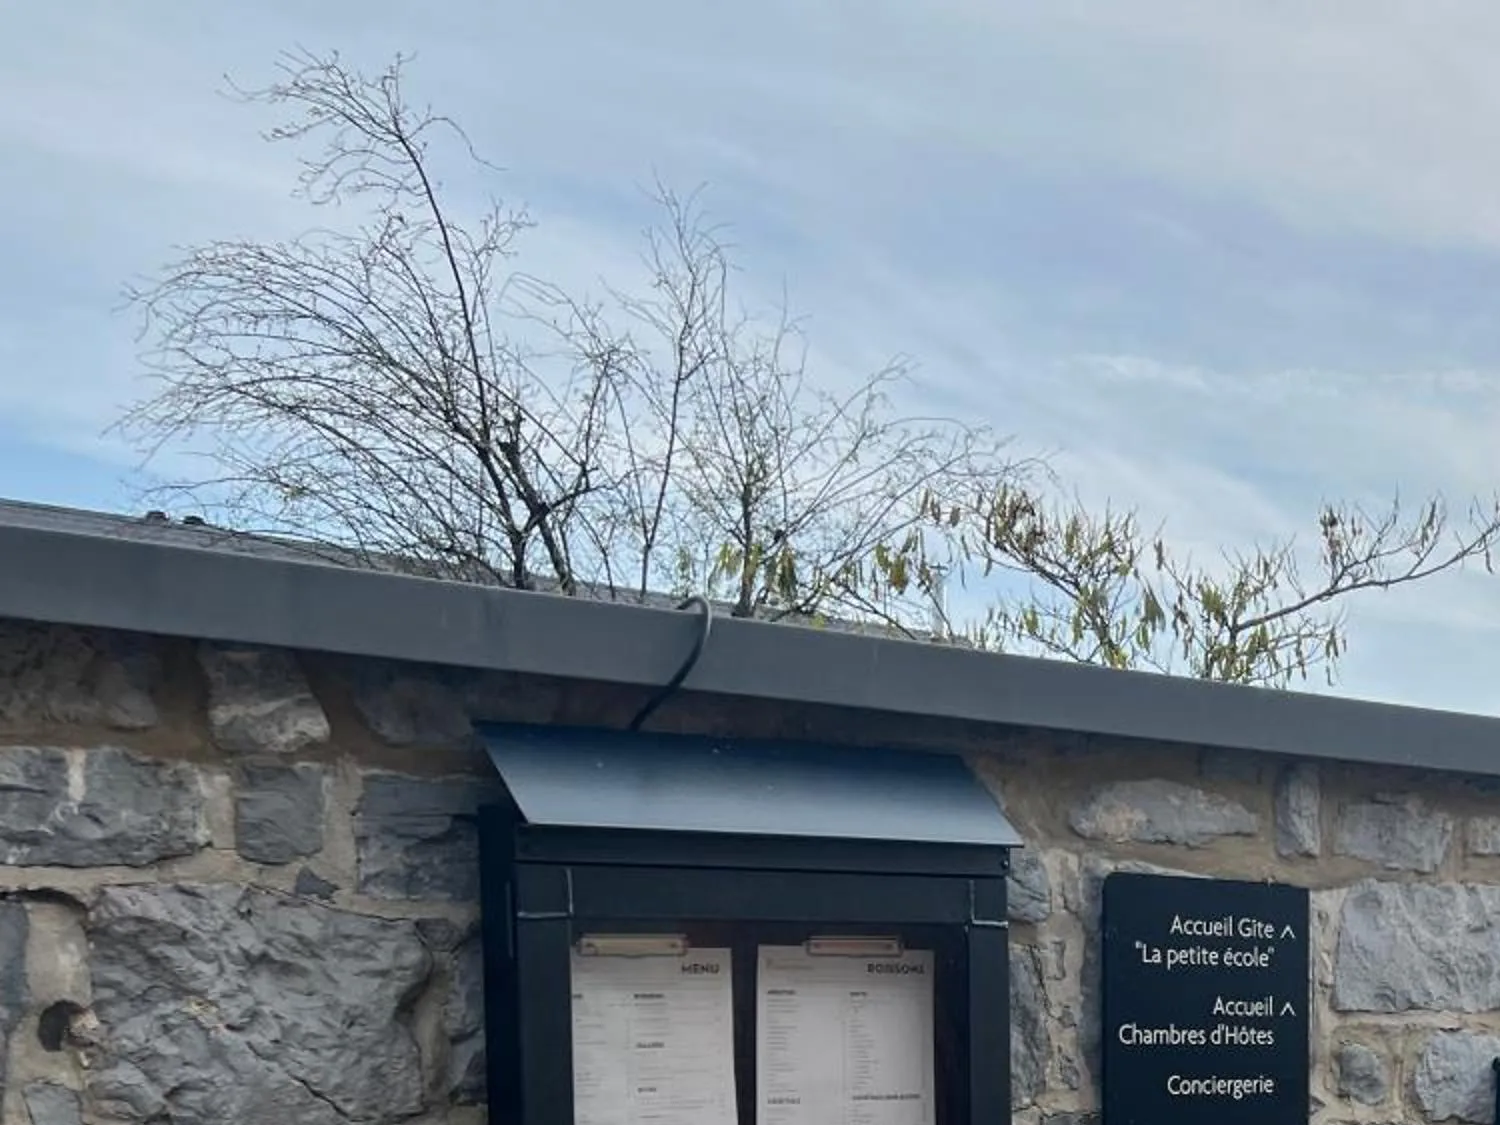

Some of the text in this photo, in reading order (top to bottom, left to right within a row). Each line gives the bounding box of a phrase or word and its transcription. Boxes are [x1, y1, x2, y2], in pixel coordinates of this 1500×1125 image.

[1170, 914, 1233, 937] Accueil
[1135, 940, 1275, 970] "La petite école"
[681, 963, 720, 975] MENU
[1212, 995, 1273, 1016] Accueil
[1118, 1023, 1274, 1045] Chambres d'Hôtes
[1167, 1075, 1274, 1100] Conciergerie
